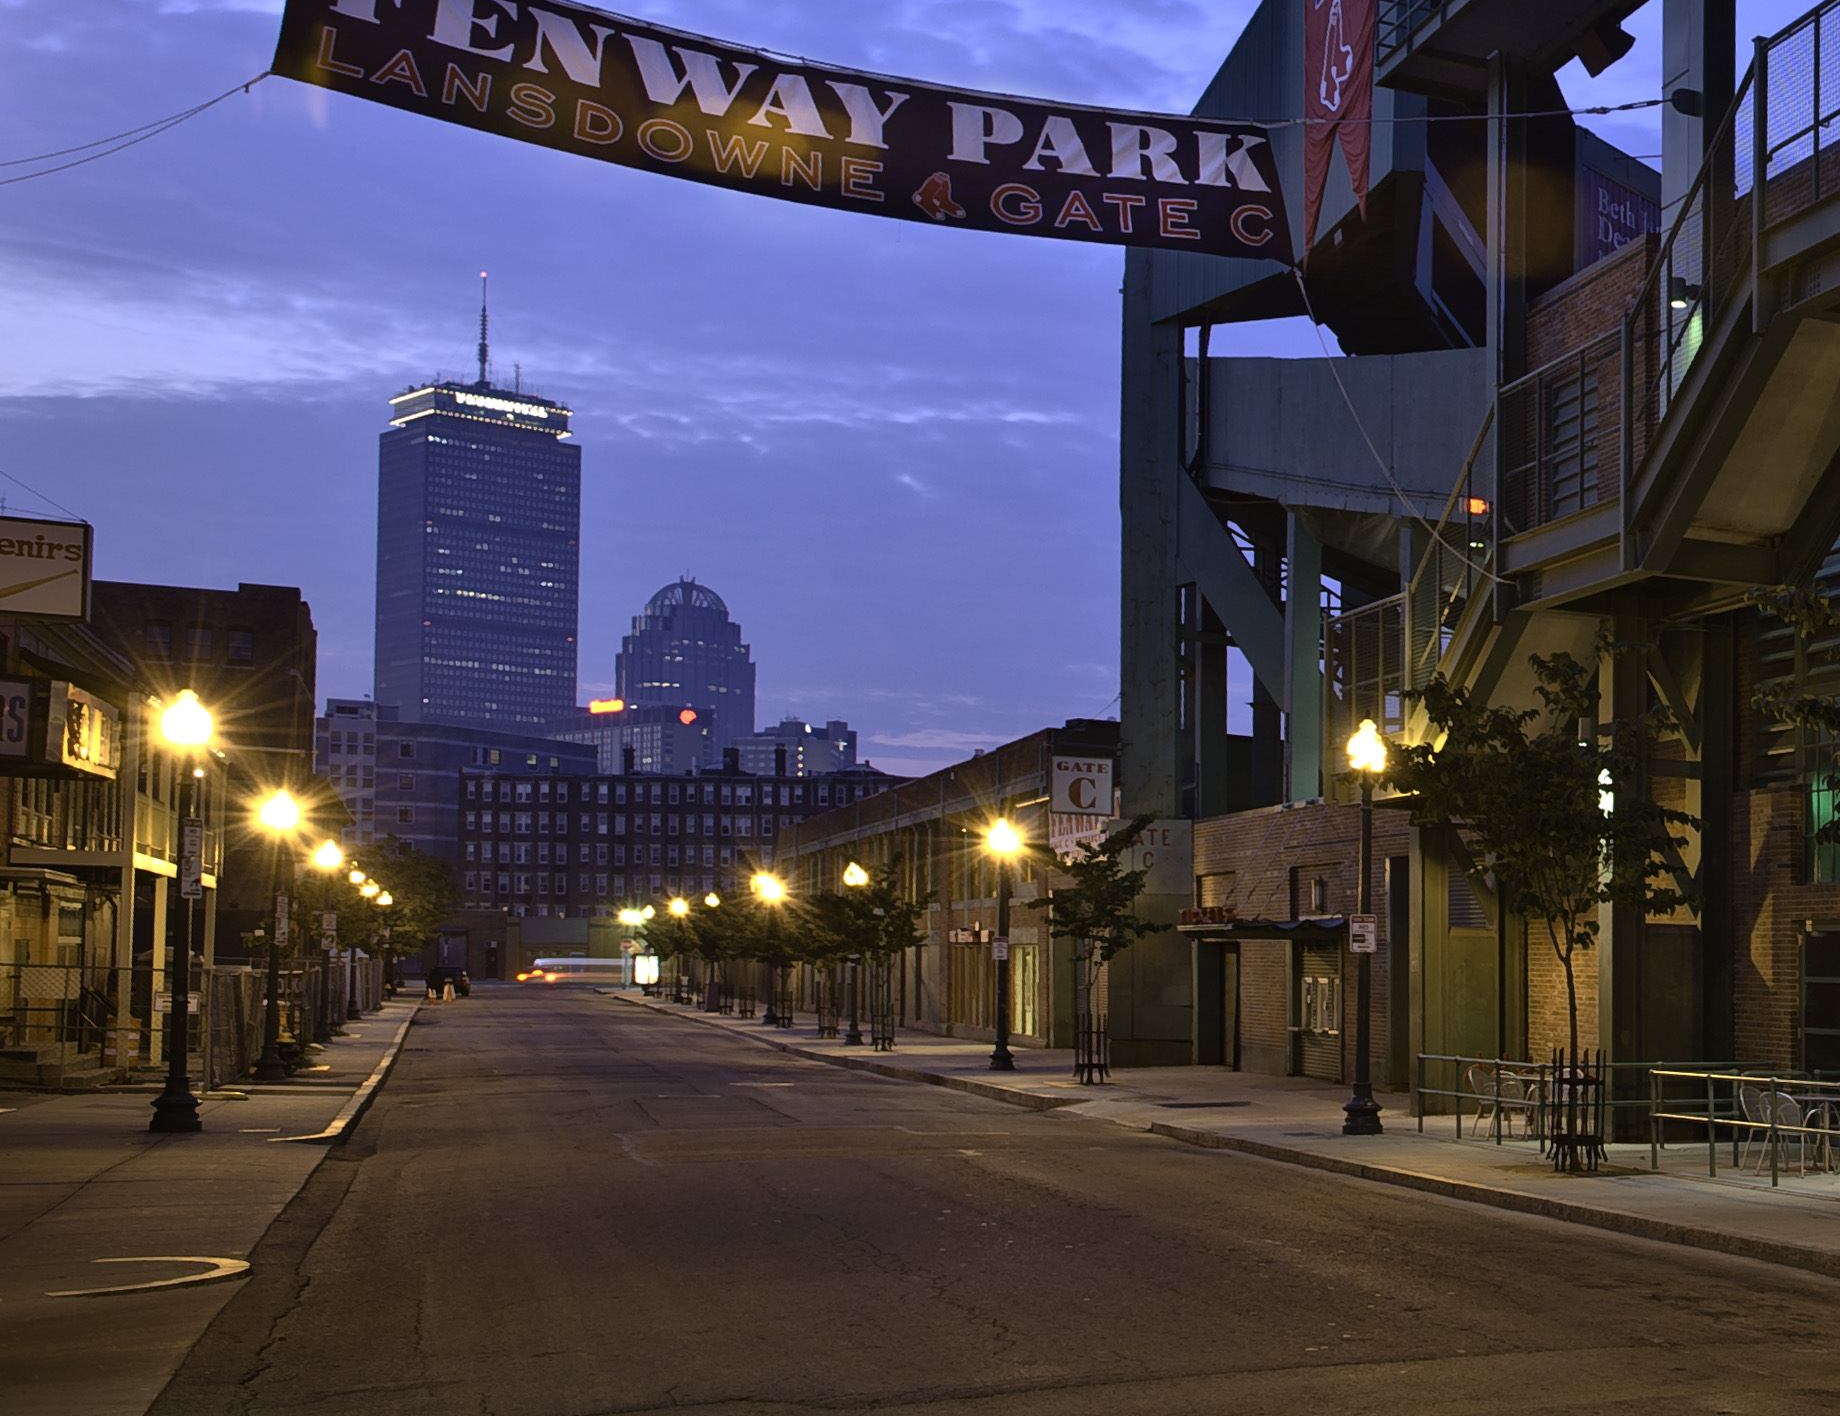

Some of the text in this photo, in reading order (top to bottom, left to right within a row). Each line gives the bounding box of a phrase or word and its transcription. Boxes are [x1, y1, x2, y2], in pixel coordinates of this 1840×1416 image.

[315, 25, 1274, 246] LANSDOWNE GATE C
[946, 101, 1273, 193] PARK
[1598, 186, 1636, 229] Beth
[1056, 760, 1110, 775] GATE
[1068, 777, 1097, 810] C
[1134, 828, 1171, 847] ATE
[1142, 851, 1155, 869] C
